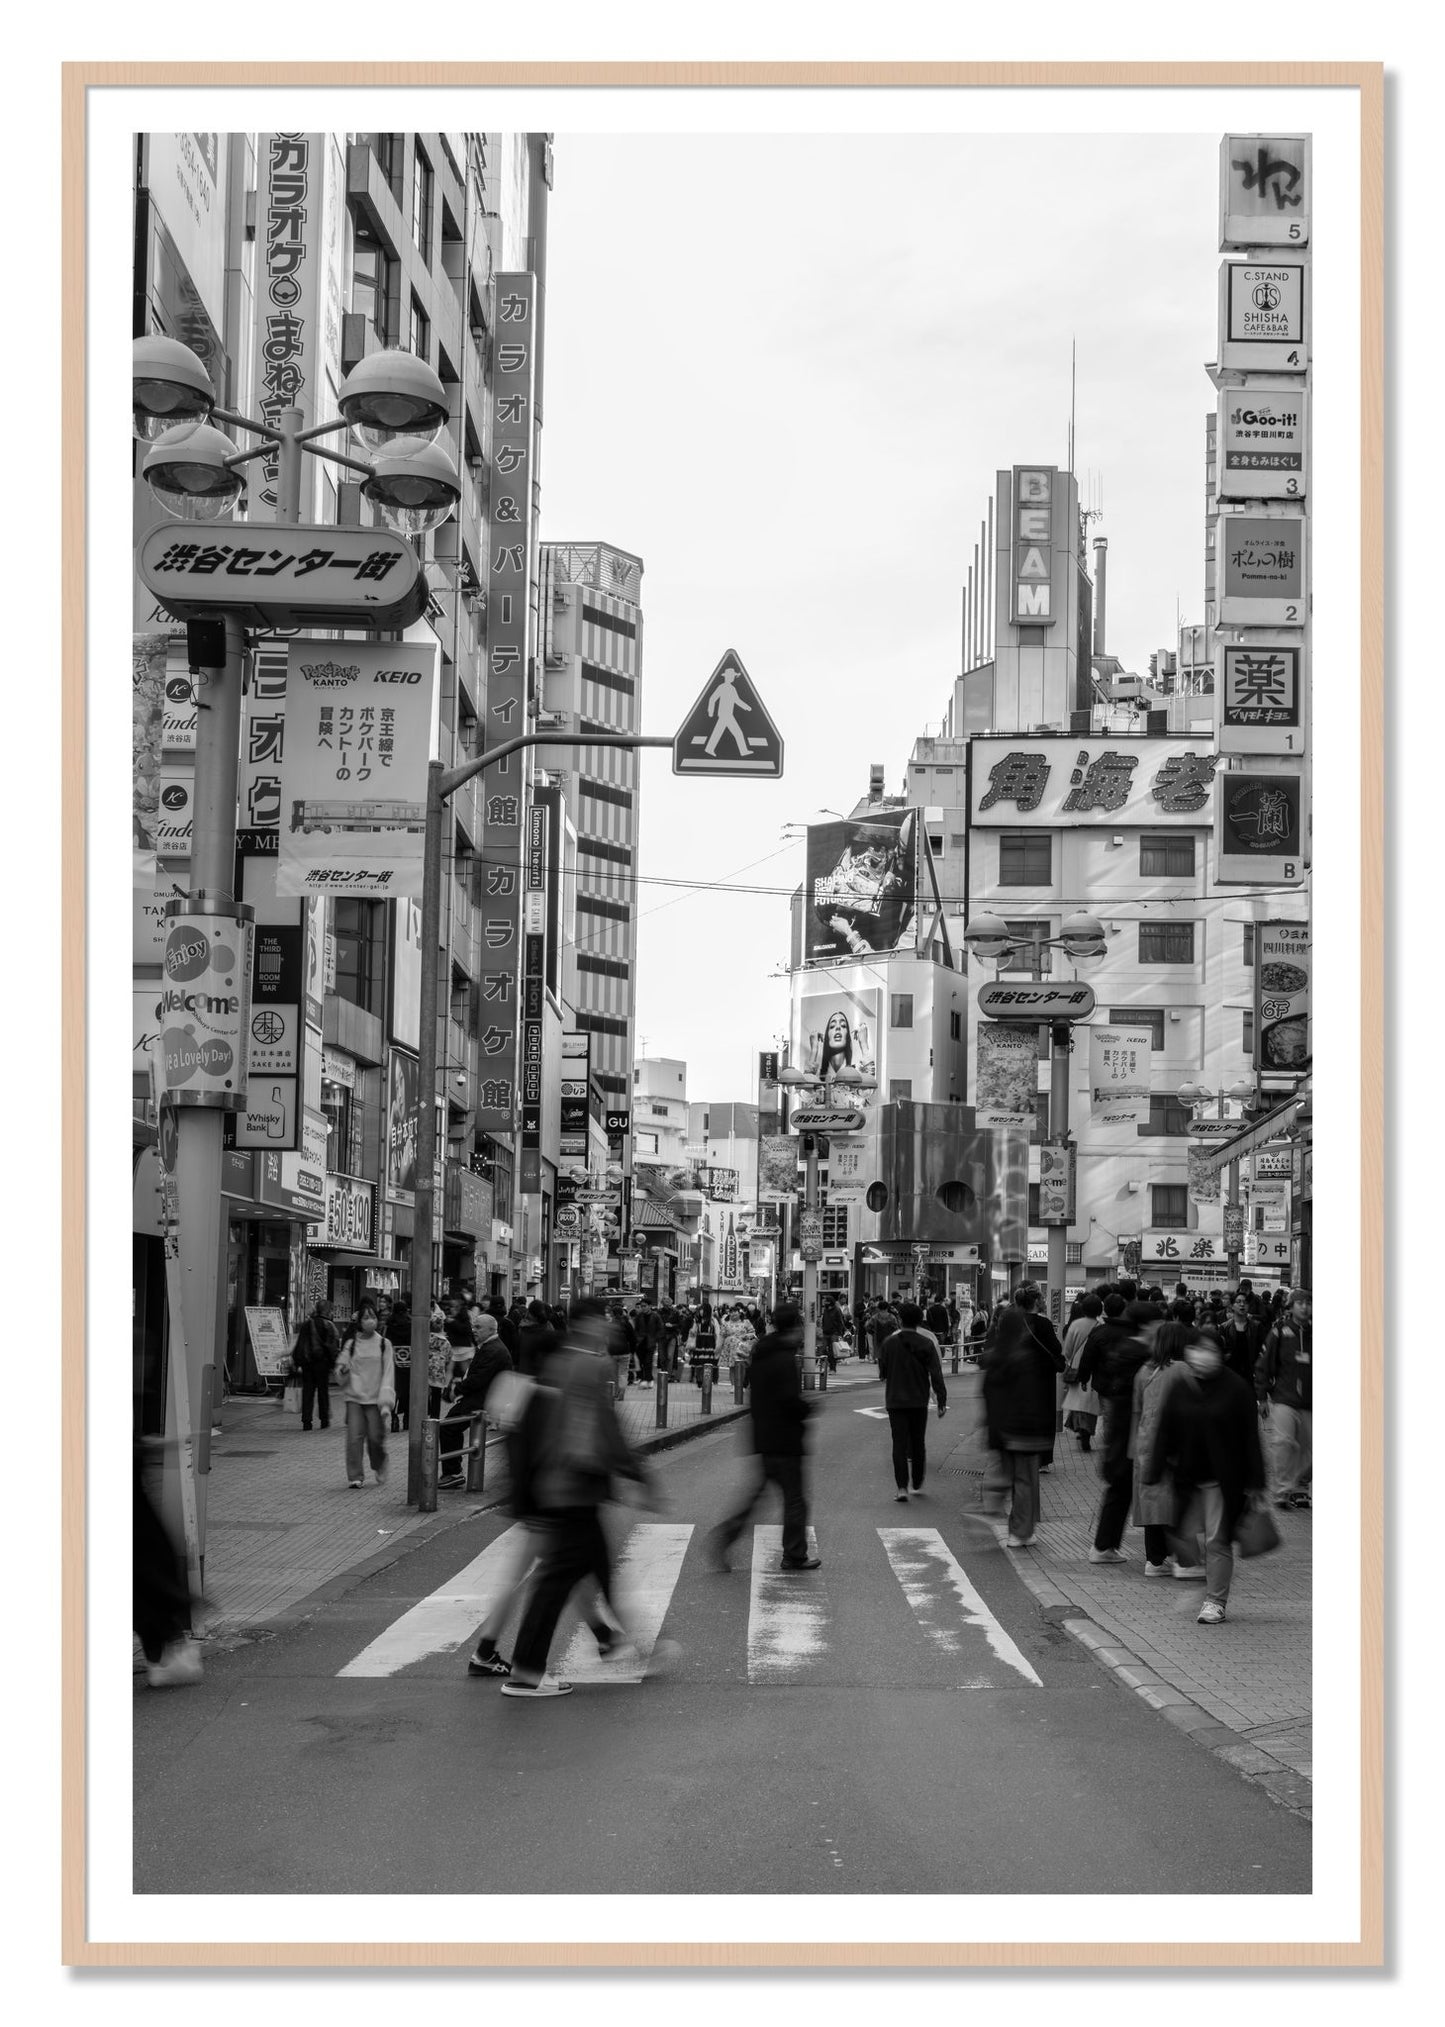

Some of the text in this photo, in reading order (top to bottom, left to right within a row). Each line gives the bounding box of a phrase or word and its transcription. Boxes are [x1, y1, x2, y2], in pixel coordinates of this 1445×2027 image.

[266, 139, 308, 275] カラオケ
[1288, 223, 1301, 239] 5
[1244, 271, 1289, 281] C.STAND
[1244, 312, 1288, 323] SHISHA
[1287, 350, 1300, 366] 4
[1242, 410, 1297, 426] Goo-it!
[1235, 430, 1294, 439] 渋谷宇田川町店
[1230, 455, 1298, 467] 全身もみほぐし
[1286, 478, 1298, 495] 3
[1018, 470, 1052, 616] BEAM
[153, 543, 403, 581] 渋谷センター街
[1285, 605, 1298, 621] 2
[313, 679, 348, 687] KANTO
[373, 670, 422, 685] KEIO
[1234, 654, 1285, 705] 薬
[1228, 708, 1290, 723] マツモトキヨシ
[317, 706, 334, 749] 冒険へ
[166, 734, 191, 743] 渋谷店
[336, 707, 354, 781] カントーの
[378, 708, 395, 767] 京王線で
[1285, 734, 1293, 750] 1
[979, 750, 1219, 812] 角海老
[1228, 790, 1290, 839] 一蘭
[162, 842, 188, 851] 渋谷店
[532, 810, 542, 887] kimono hearts
[304, 869, 394, 883] 渋谷センター街
[1284, 863, 1296, 879] B
[166, 939, 207, 975] Enjoy
[259, 945, 281, 953] THIRD
[262, 984, 277, 992] BAR
[480, 866, 515, 1110] カラオケ館
[162, 989, 239, 1015] Welcome
[985, 990, 1088, 1004] 渋谷センター街
[1261, 1000, 1290, 1020] 6F
[179, 1047, 210, 1067] Lovely
[211, 1049, 232, 1063] Day!
[247, 1113, 280, 1125] Whisky
[607, 1117, 628, 1128] GU
[793, 1114, 856, 1123] 渋谷センター街
[246, 1123, 267, 1131] Bank
[1190, 1123, 1247, 1132] 渋谷センター街
[1155, 1236, 1215, 1259] 兆楽
[727, 1235, 736, 1278] BEER
